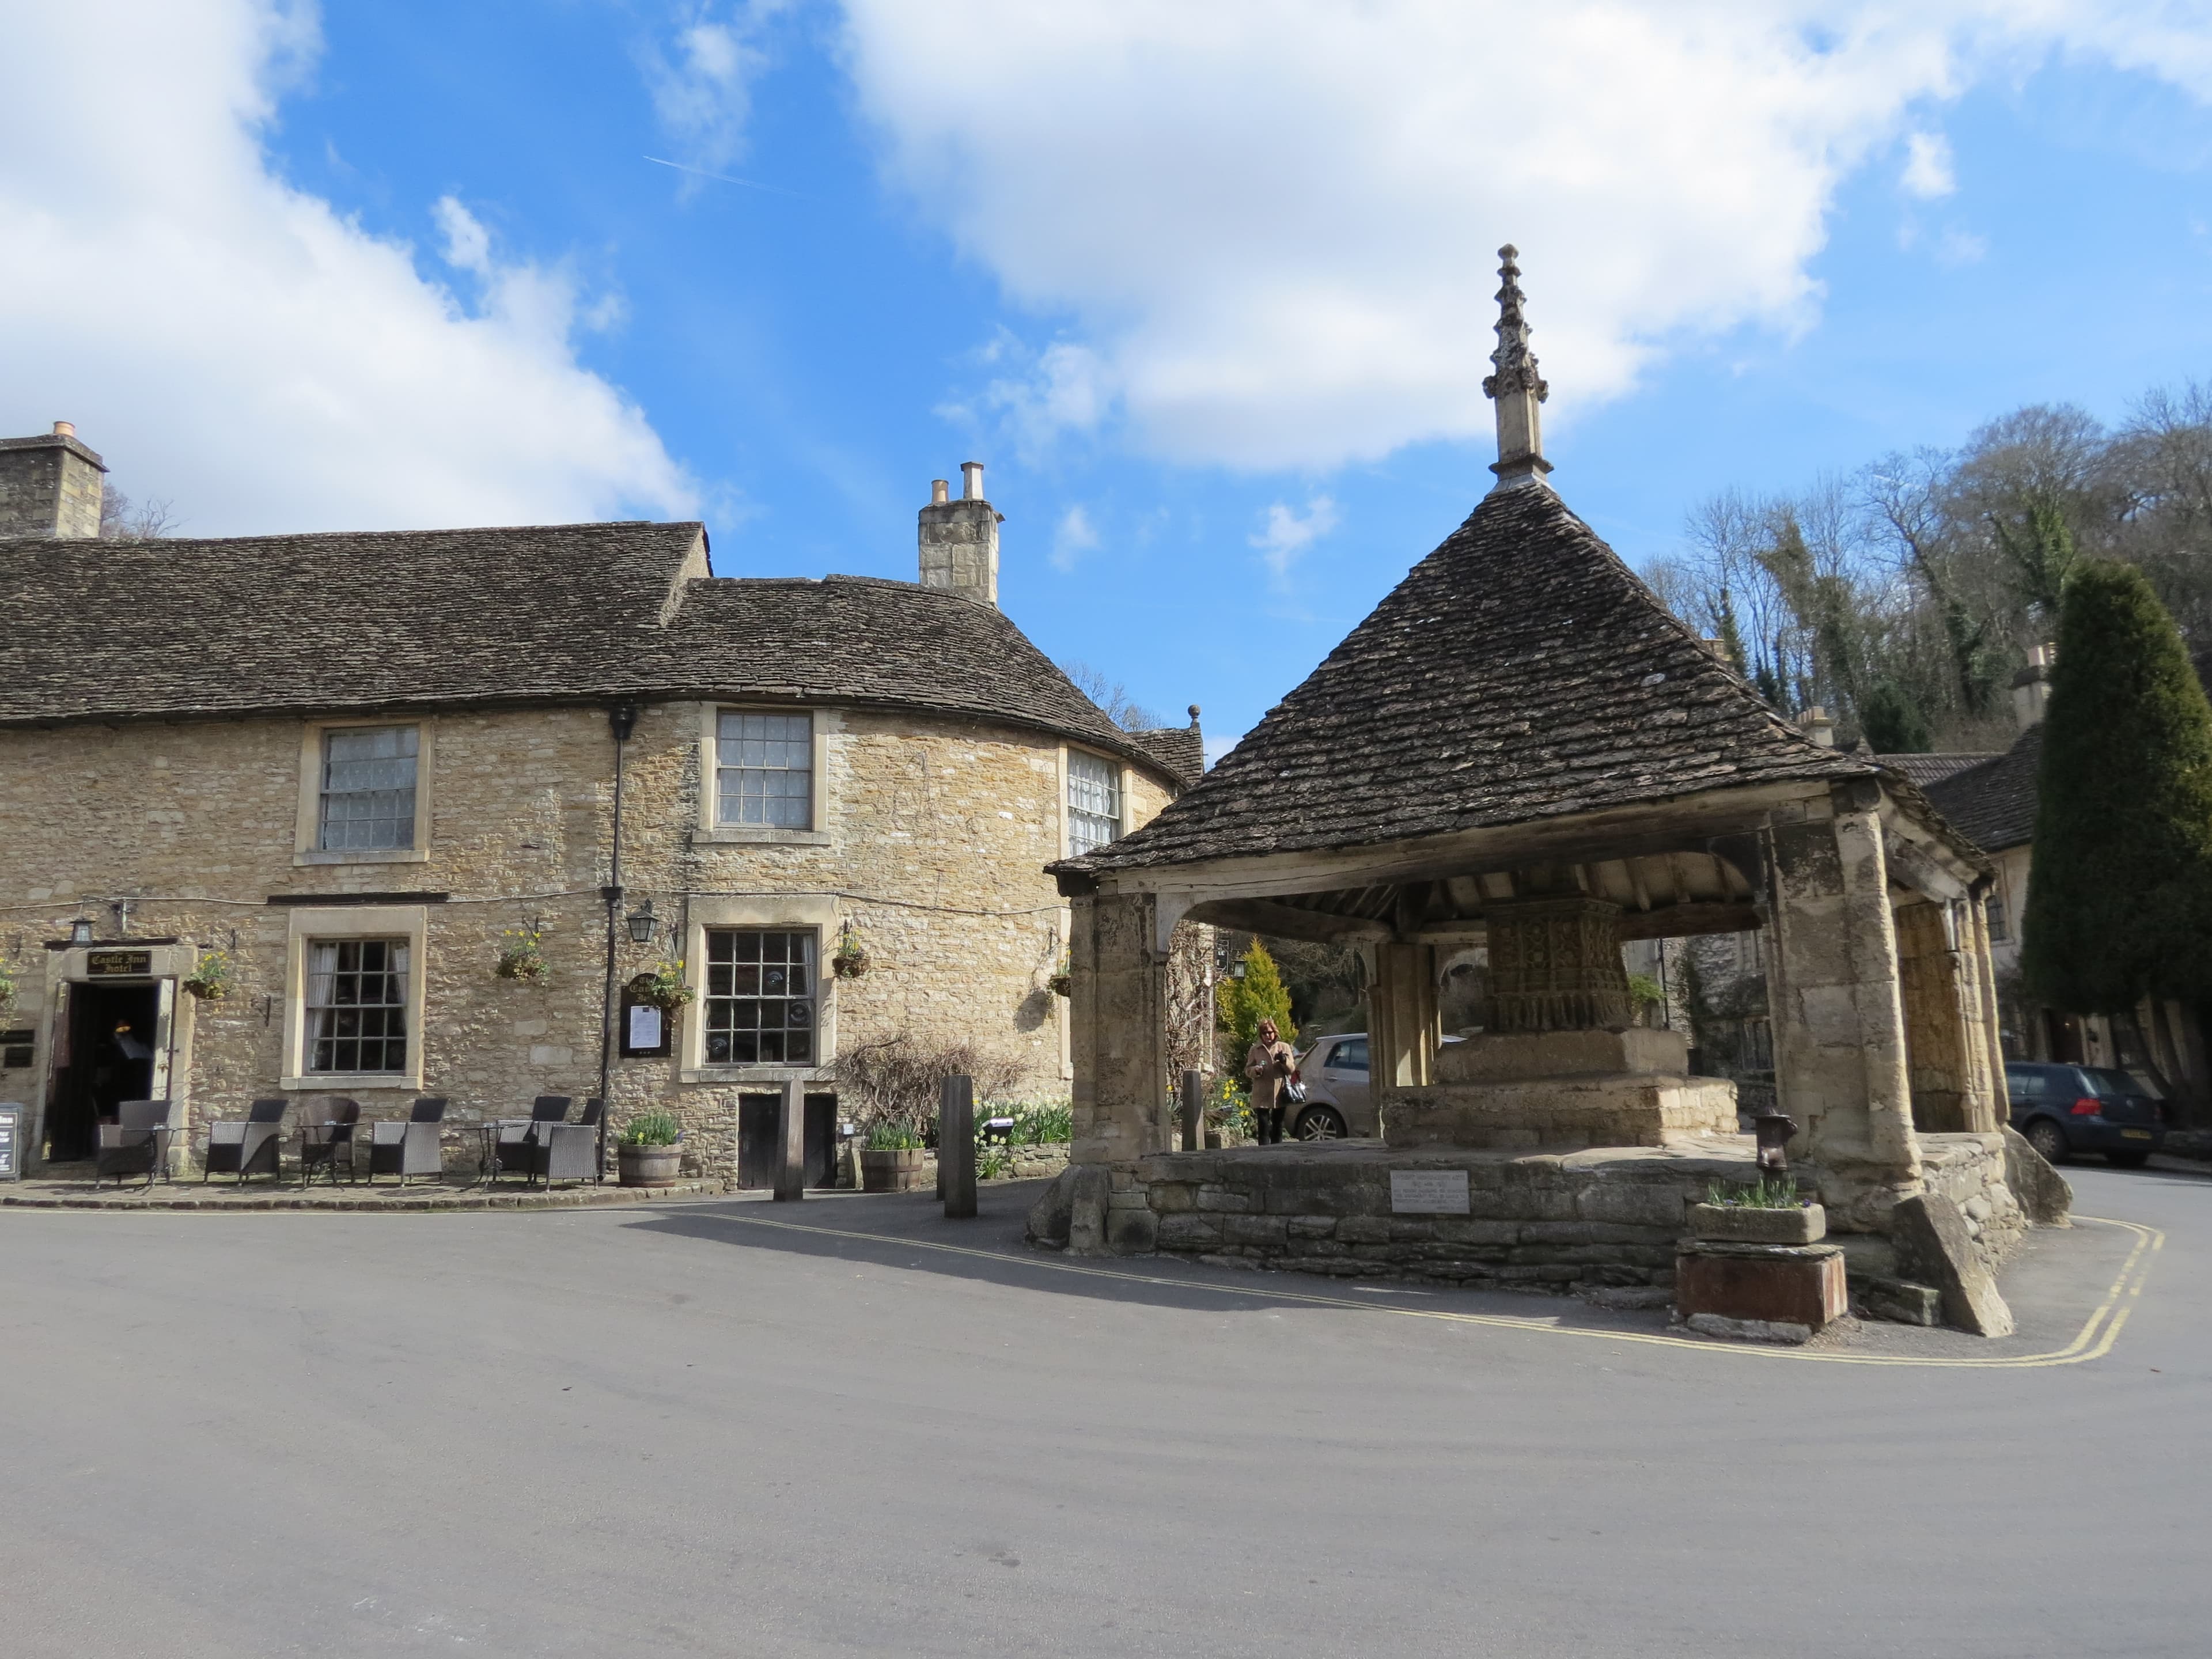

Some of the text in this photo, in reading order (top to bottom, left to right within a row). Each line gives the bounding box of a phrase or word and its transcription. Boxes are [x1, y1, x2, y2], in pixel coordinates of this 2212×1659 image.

[92, 955, 146, 964] Castle Inn
[104, 964, 132, 973] Hotel
